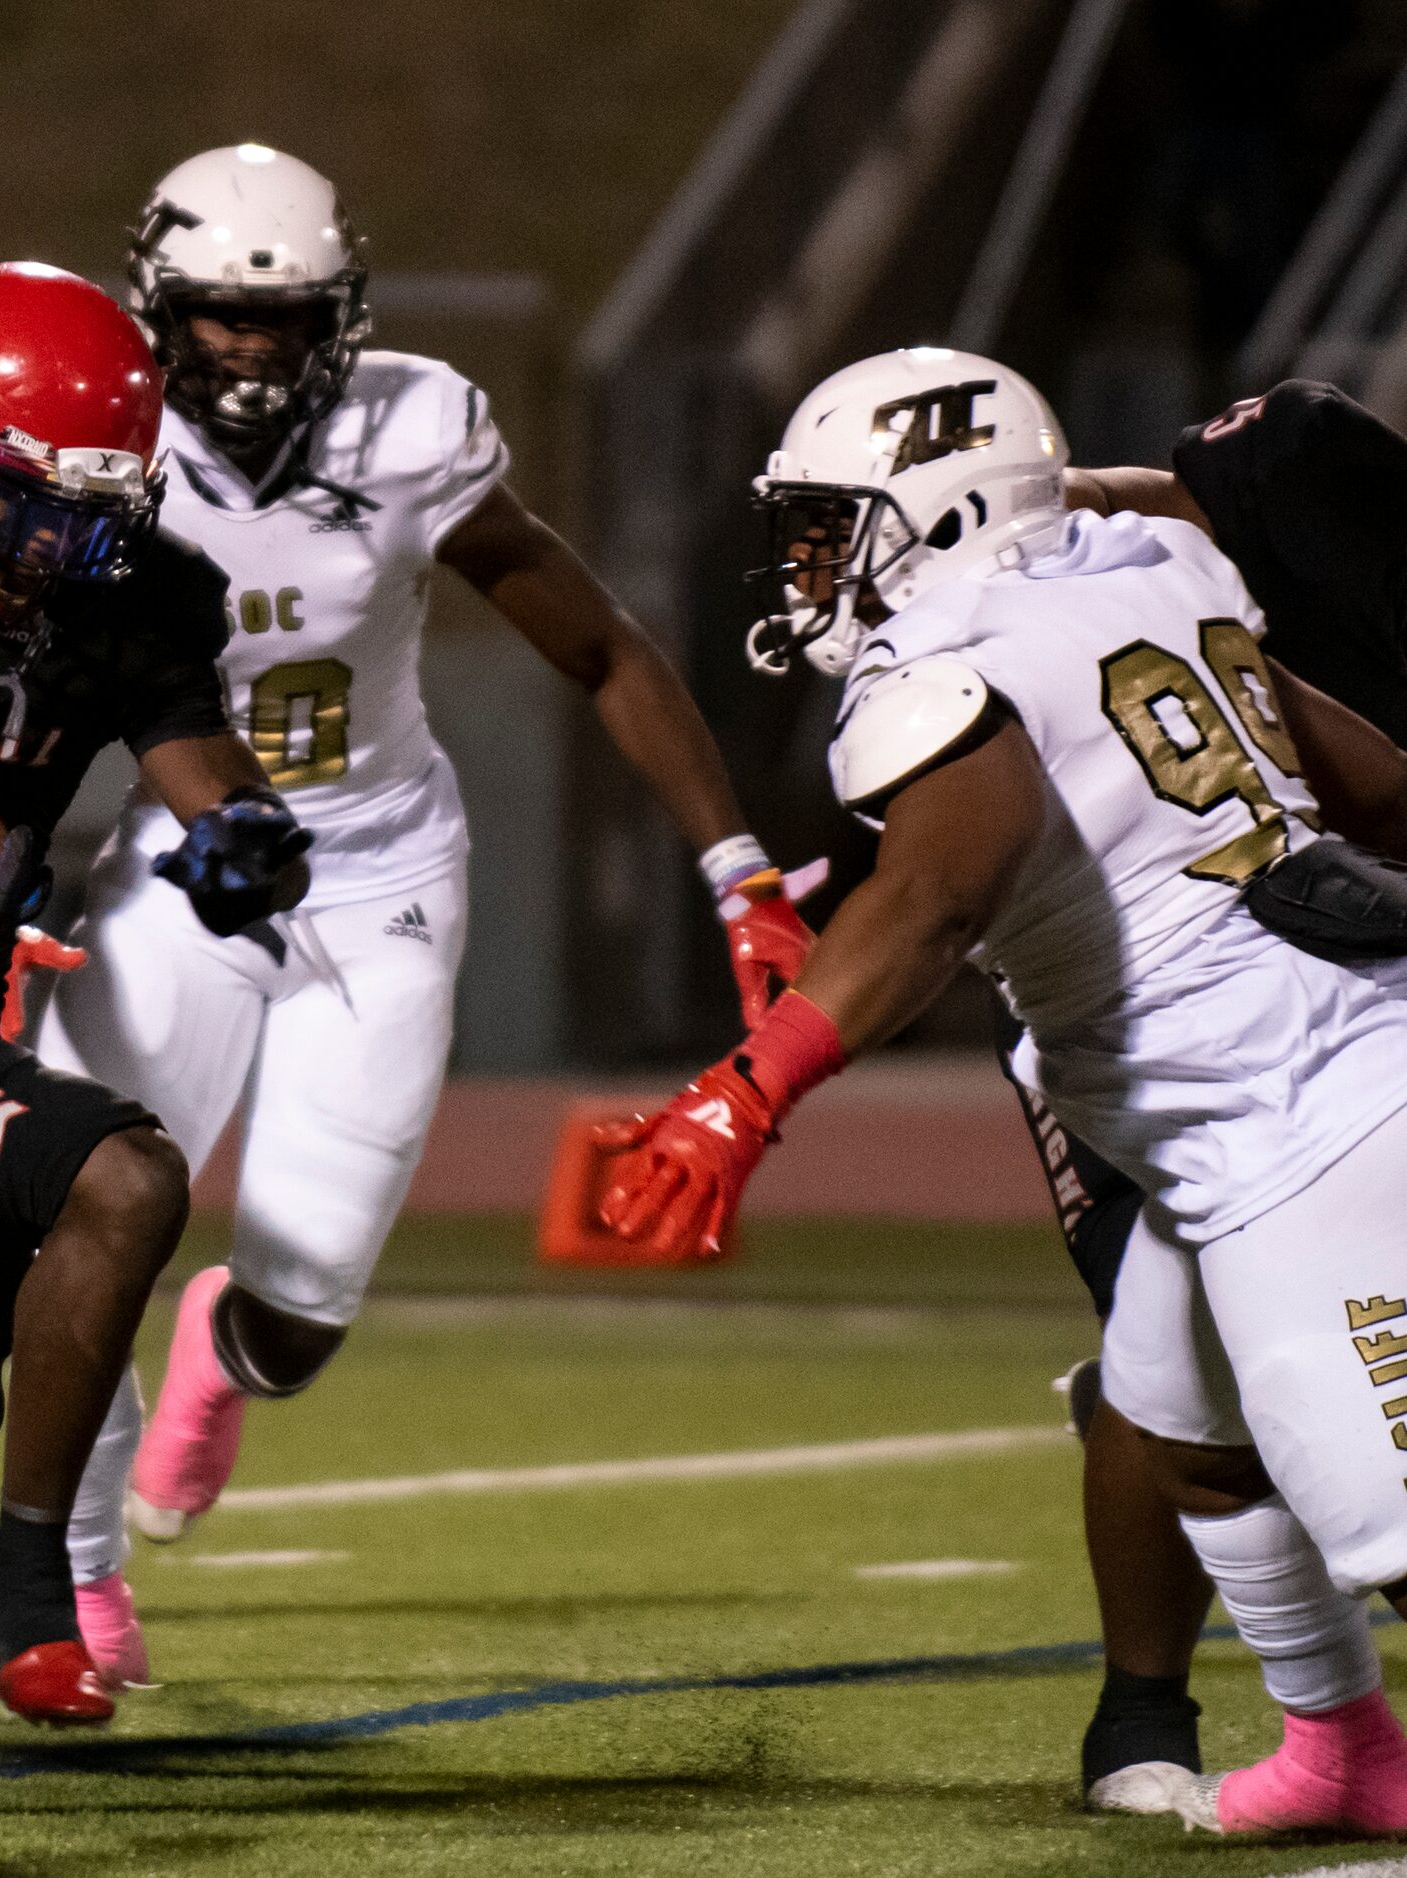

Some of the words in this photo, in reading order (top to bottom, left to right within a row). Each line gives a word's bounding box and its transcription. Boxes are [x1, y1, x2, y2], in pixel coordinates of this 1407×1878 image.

[308, 518, 373, 533] adidas
[224, 586, 305, 635] OC
[384, 925, 433, 945] adidas
